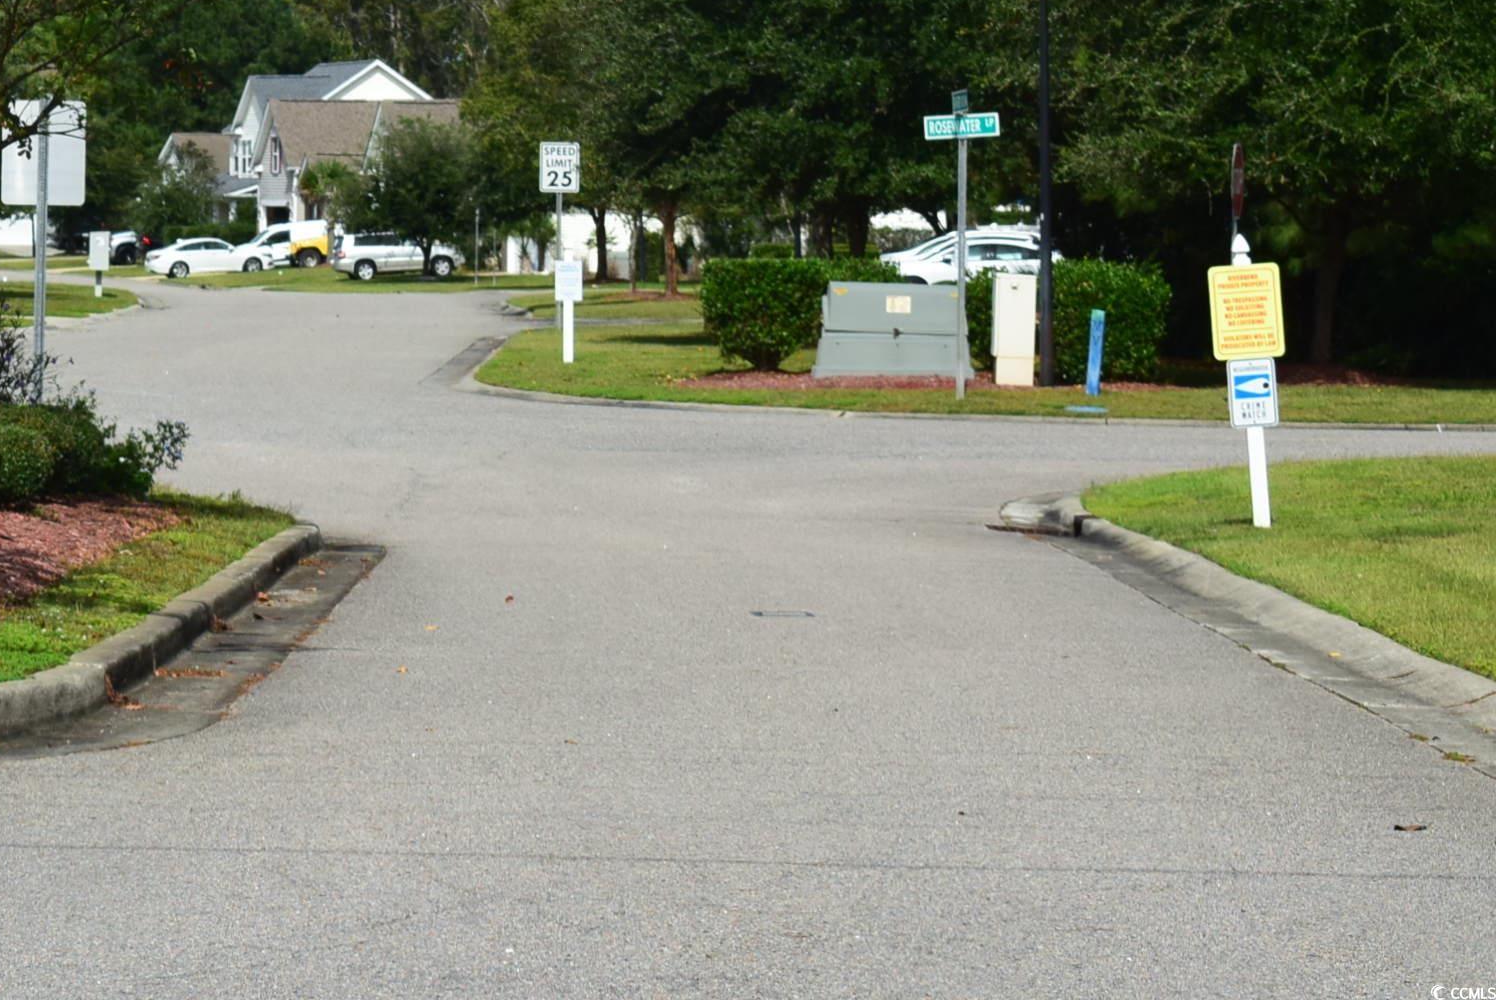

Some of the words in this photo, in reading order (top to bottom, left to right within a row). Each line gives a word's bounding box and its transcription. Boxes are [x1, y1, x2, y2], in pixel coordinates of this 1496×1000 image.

[928, 118, 982, 136] ROSEWATER
[985, 117, 994, 128] LP
[544, 147, 575, 156] SPEED
[546, 159, 572, 168] LIMIT
[547, 171, 572, 187] 25
